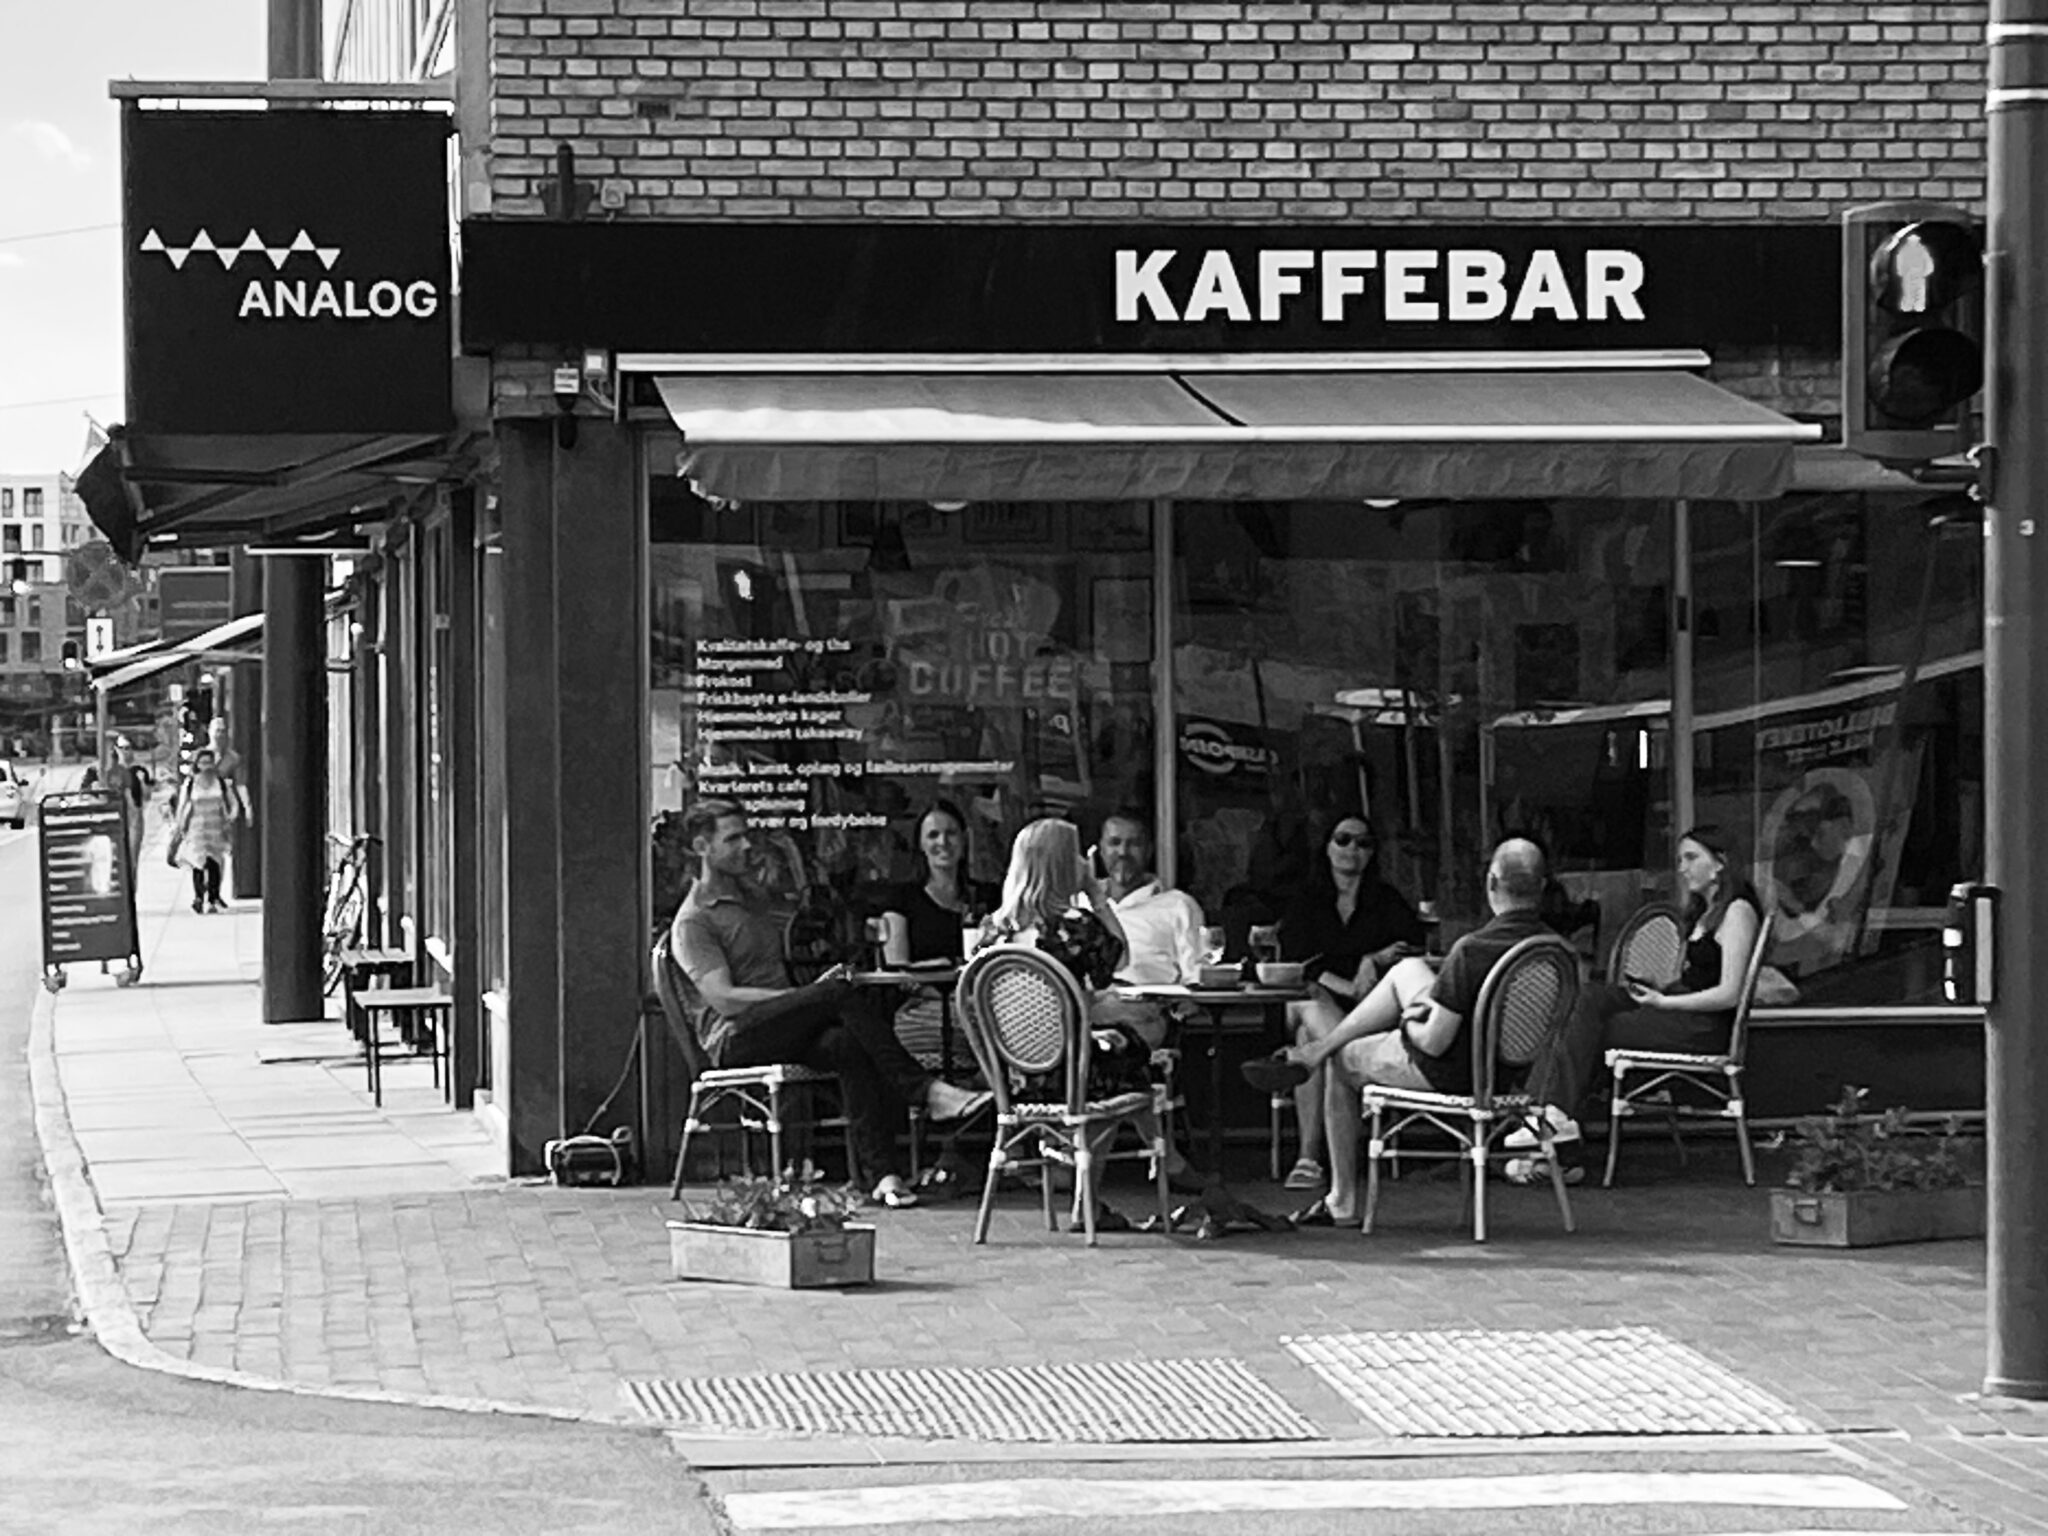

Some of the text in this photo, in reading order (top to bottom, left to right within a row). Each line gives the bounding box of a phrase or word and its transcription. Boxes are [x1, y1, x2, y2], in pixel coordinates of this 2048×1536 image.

[1115, 249, 1646, 321] KAFFEBAR
[238, 280, 438, 318] ANALOG
[804, 640, 824, 654] og
[696, 656, 783, 672] Morgenmad
[695, 674, 752, 688] Frokost
[909, 655, 1074, 699] COFFEE
[748, 761, 793, 776] kunst,
[844, 763, 862, 777] og
[698, 781, 774, 793] Kvarterets
[788, 817, 808, 831] og
